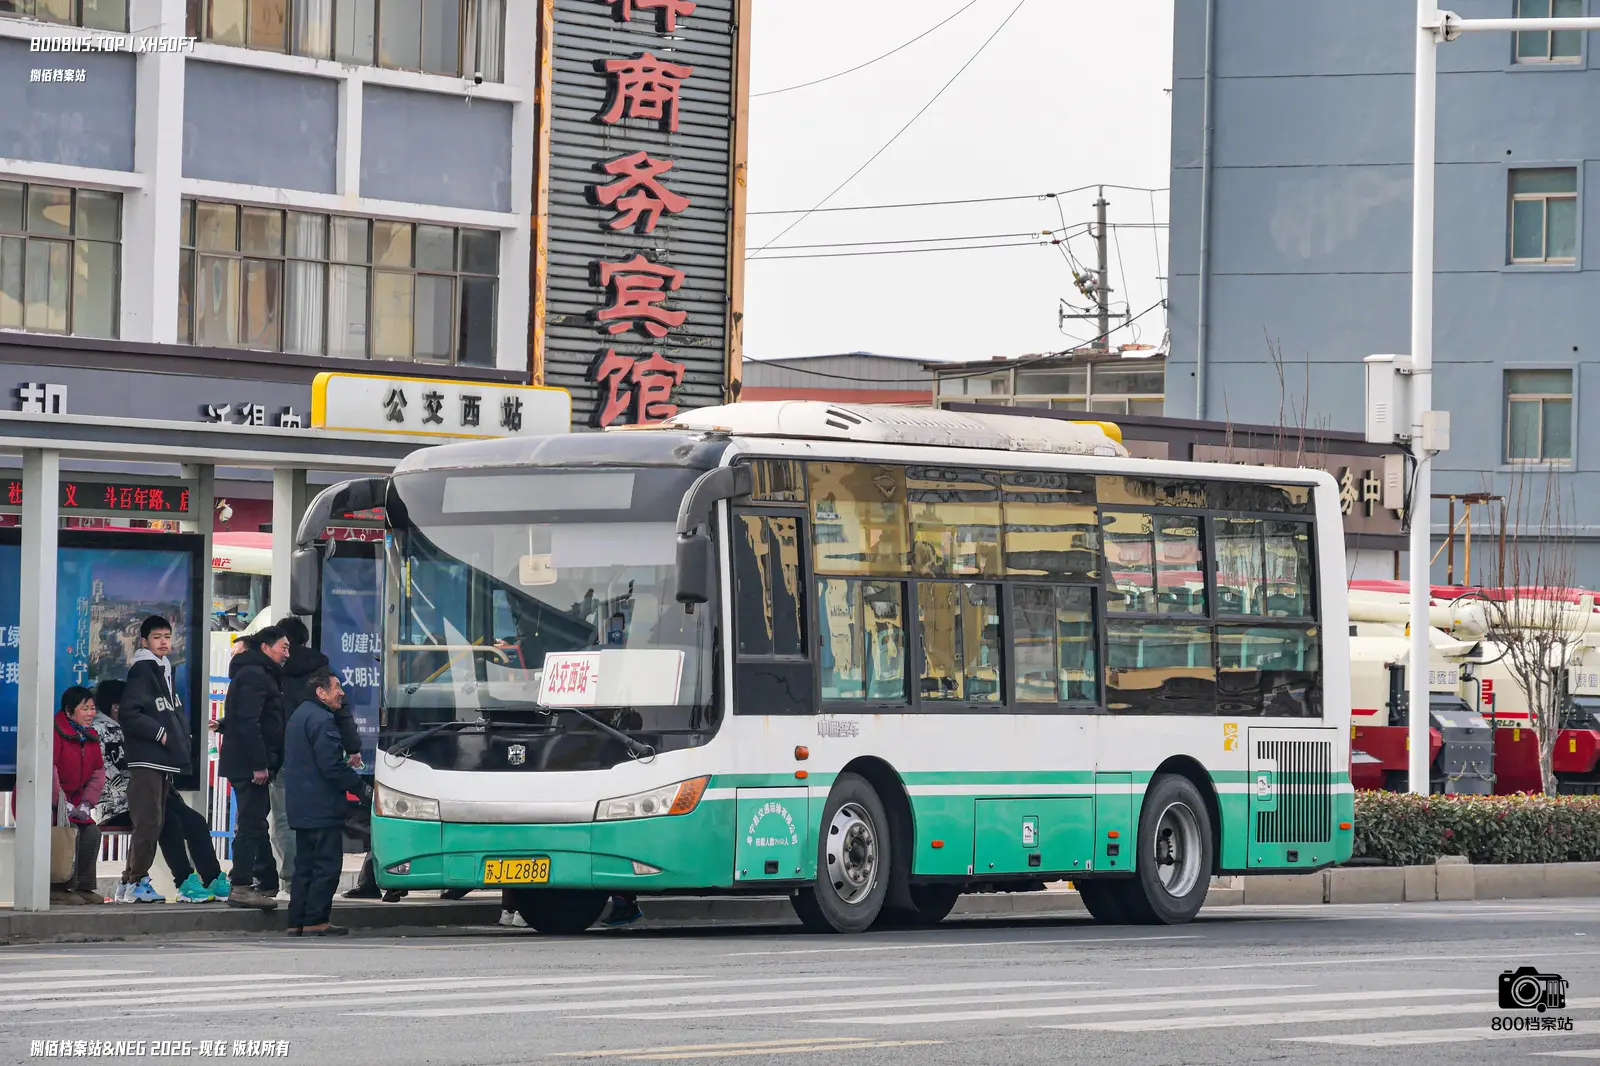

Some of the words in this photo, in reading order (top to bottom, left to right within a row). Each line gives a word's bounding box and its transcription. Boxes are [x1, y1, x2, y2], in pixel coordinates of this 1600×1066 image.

[383, 388, 524, 431] 公交西站
[341, 631, 381, 654] 创建让
[341, 666, 380, 688] 文明让
[548, 660, 591, 694] 公交西站
